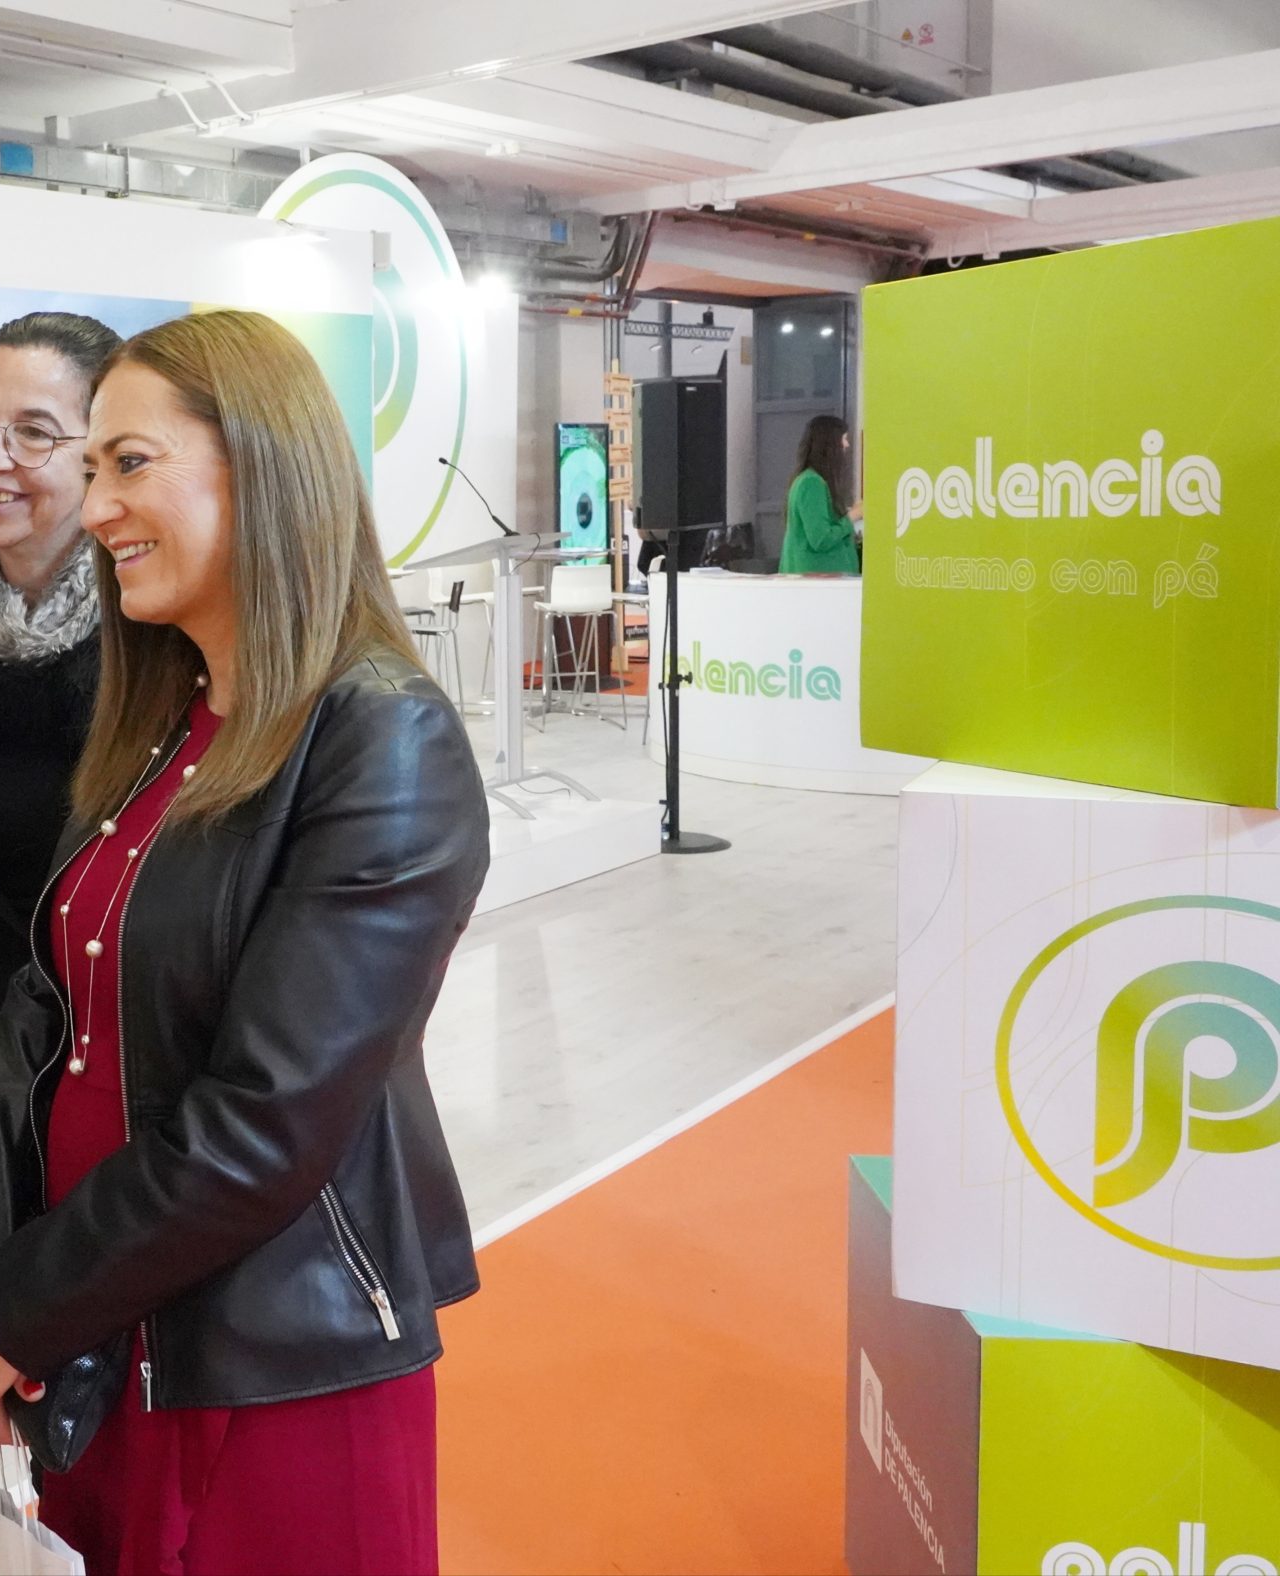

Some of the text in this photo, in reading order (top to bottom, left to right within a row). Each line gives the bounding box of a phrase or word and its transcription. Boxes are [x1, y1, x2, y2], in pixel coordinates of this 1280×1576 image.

[896, 429, 1221, 538] palencia
[895, 546, 1036, 592] turismo
[1049, 558, 1138, 595] con
[666, 640, 841, 701] alencia
[884, 1446, 946, 1575] DE PALENCIA
[885, 1409, 933, 1513] Diputación
